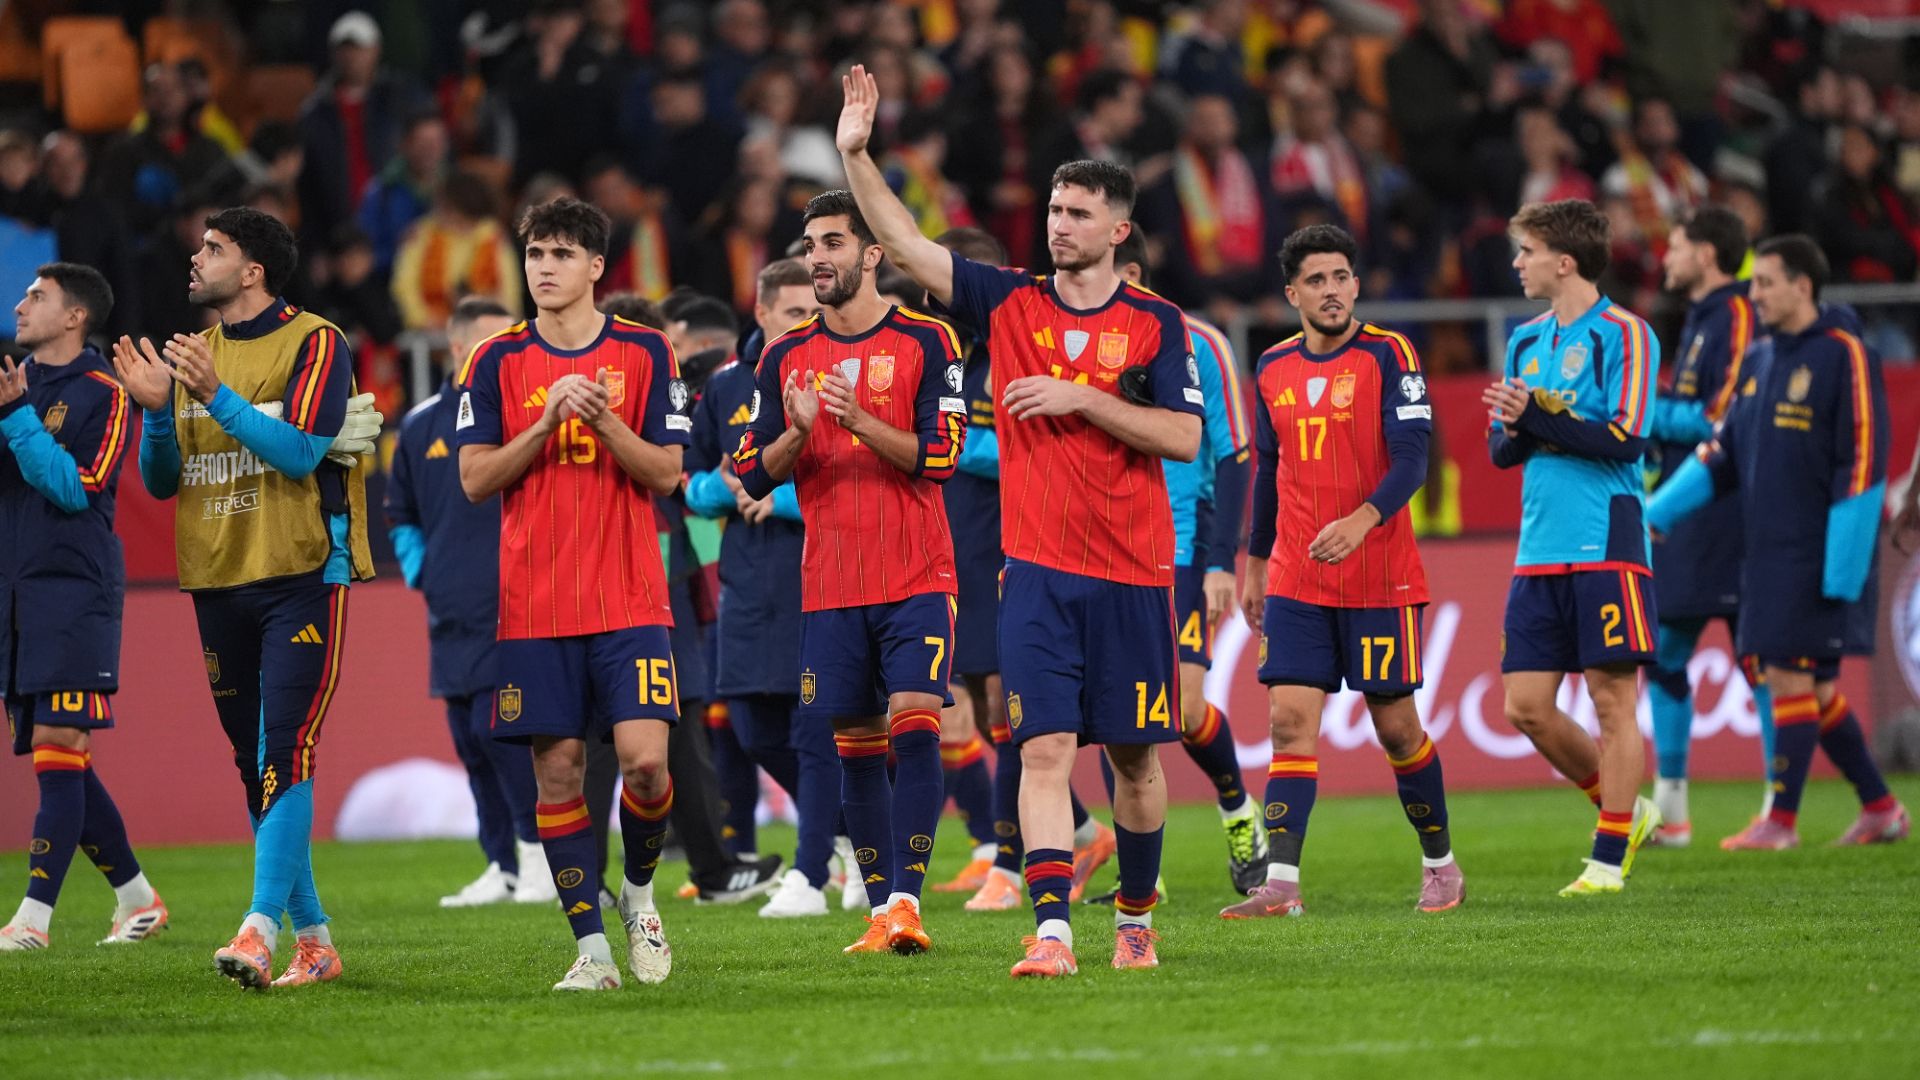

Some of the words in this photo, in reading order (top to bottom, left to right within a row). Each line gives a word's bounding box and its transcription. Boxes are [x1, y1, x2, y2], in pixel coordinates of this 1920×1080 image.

[558, 418, 596, 465] 15
[1297, 417, 1327, 461] 17
[1600, 603, 1624, 647] 2
[925, 636, 945, 681] 7
[1361, 637, 1395, 680] 17
[635, 658, 672, 705] 15
[1136, 682, 1170, 728] 14
